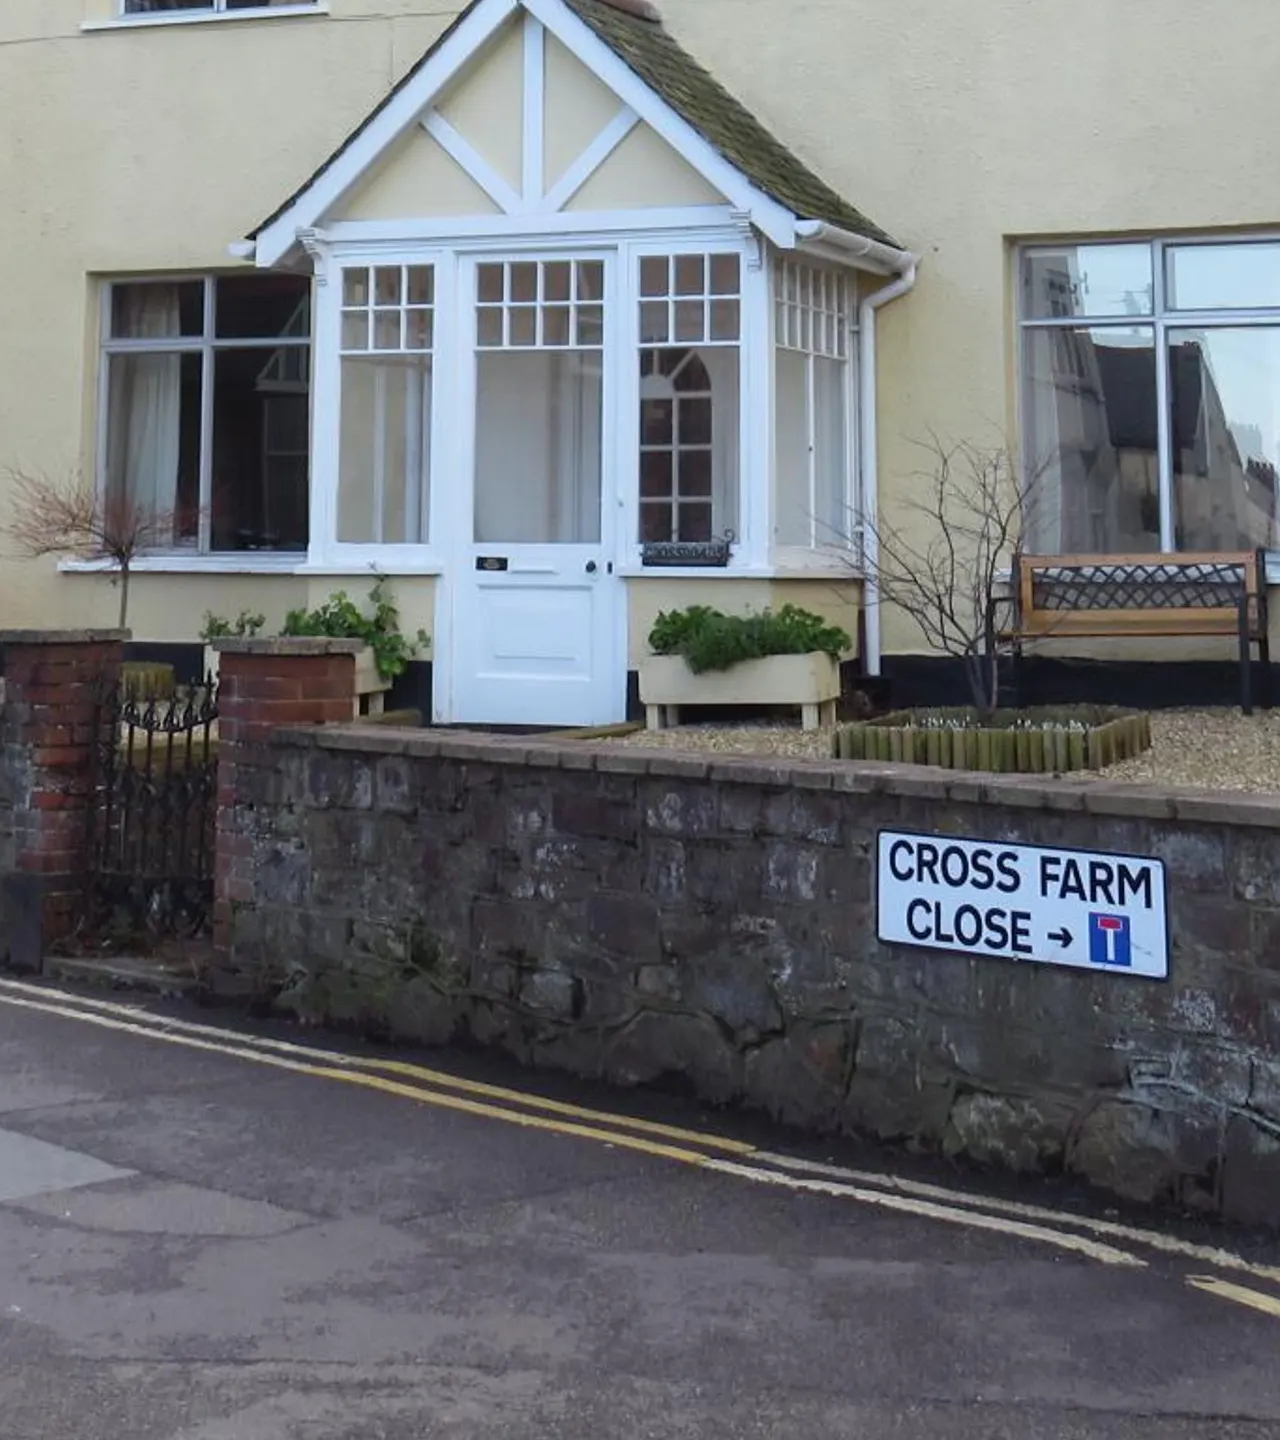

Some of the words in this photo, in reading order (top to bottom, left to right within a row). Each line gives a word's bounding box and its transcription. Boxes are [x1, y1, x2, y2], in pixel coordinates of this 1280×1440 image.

[889, 839, 1021, 893] CROSS
[1039, 855, 1153, 909] FARM
[906, 897, 1033, 954] CLOSE
